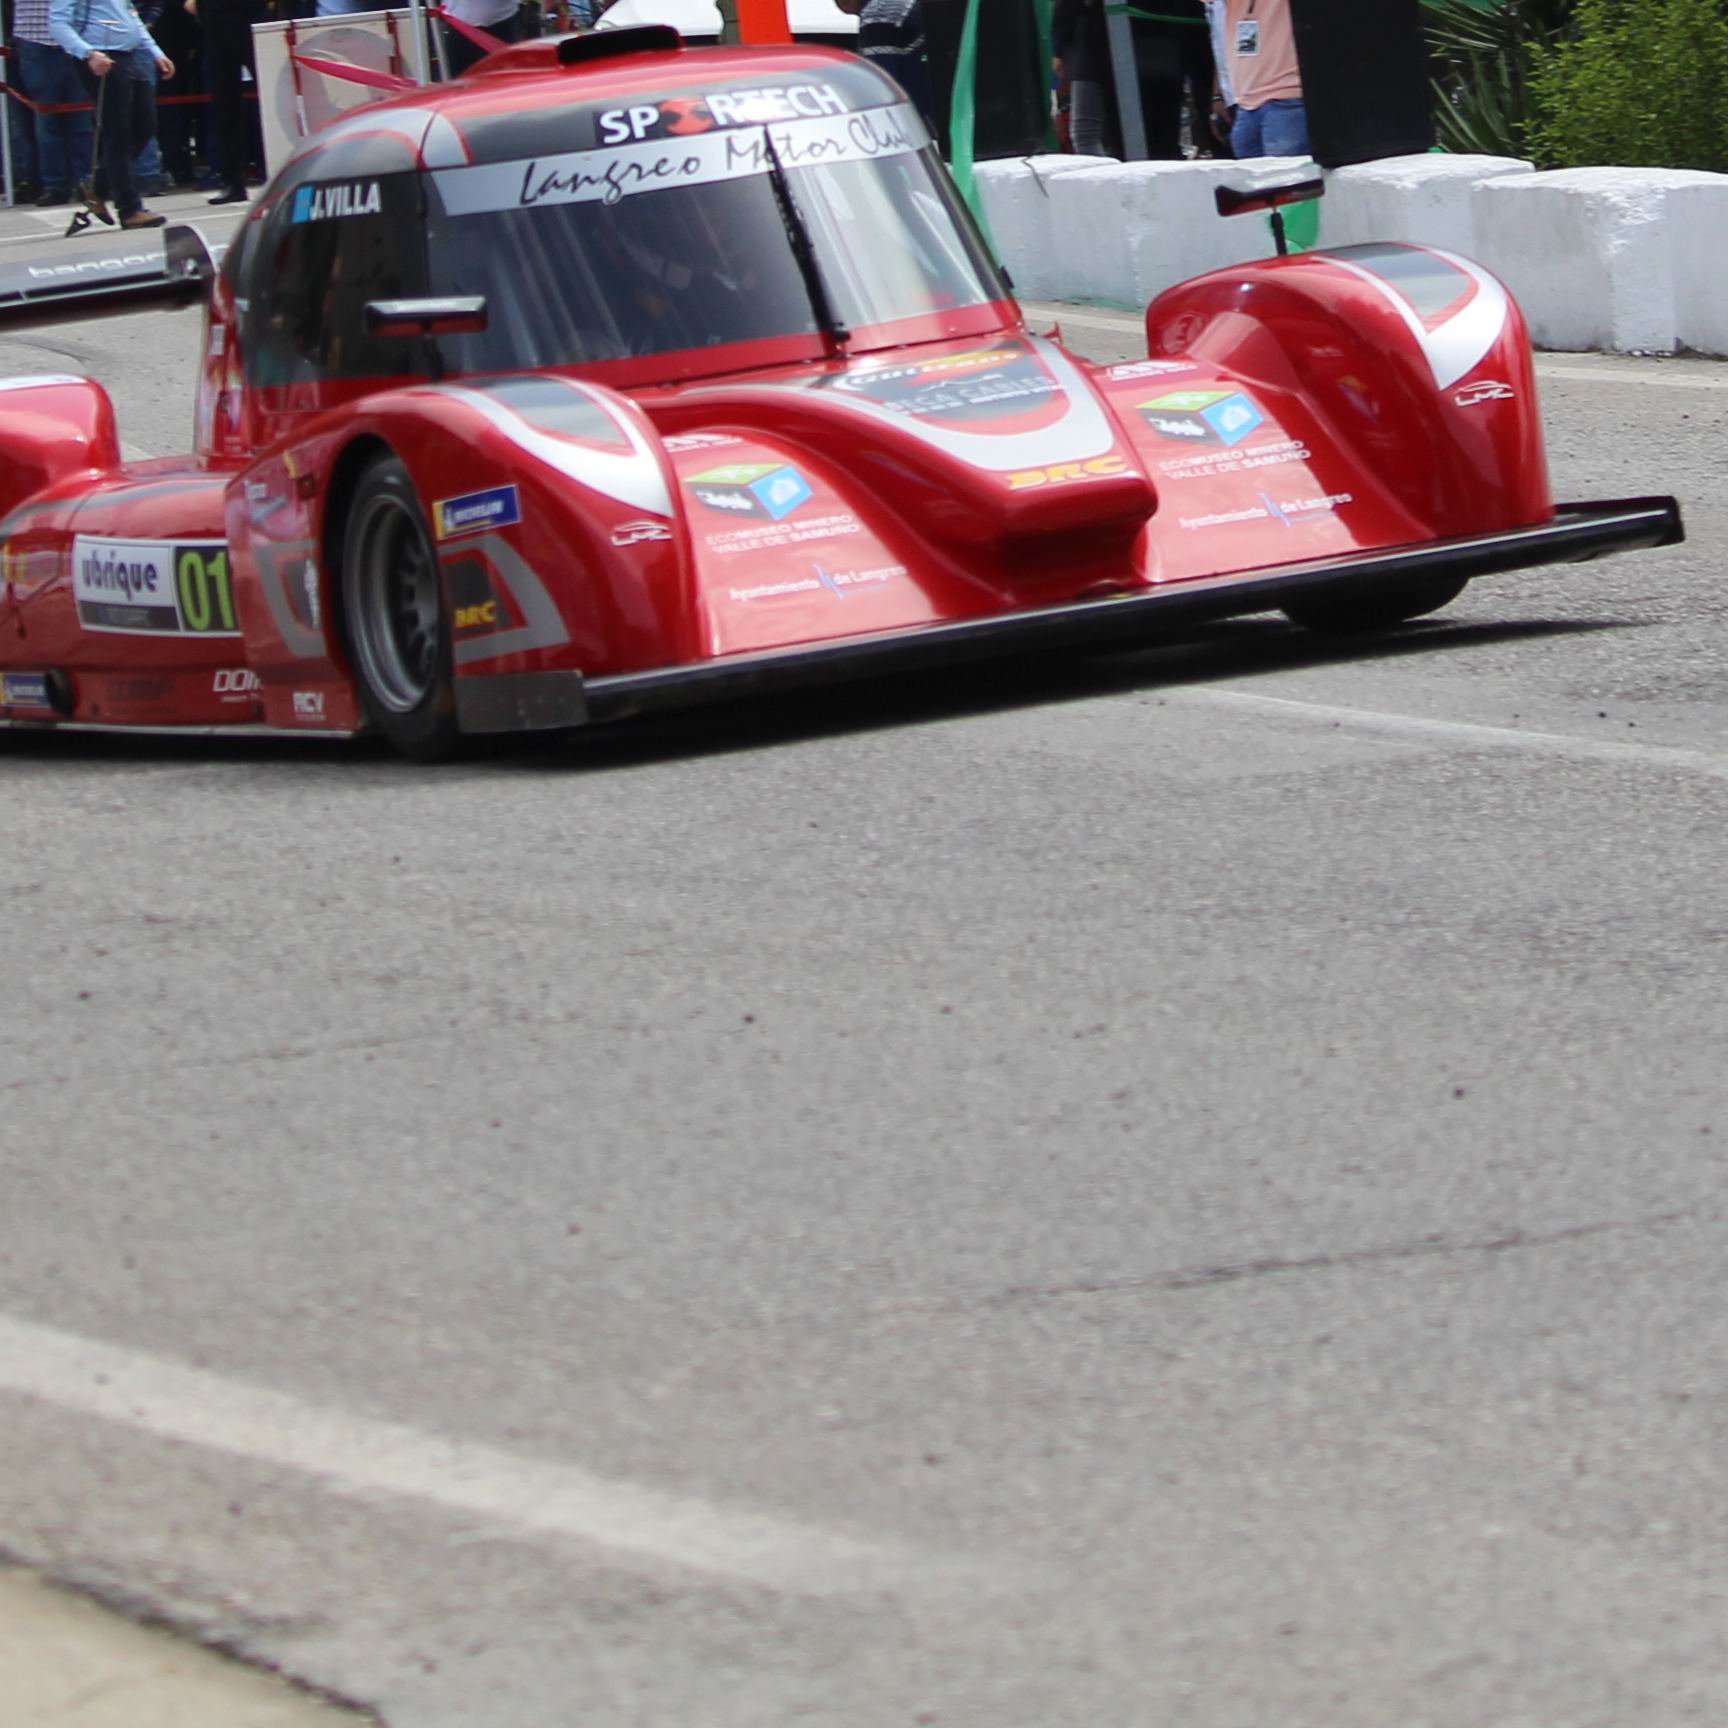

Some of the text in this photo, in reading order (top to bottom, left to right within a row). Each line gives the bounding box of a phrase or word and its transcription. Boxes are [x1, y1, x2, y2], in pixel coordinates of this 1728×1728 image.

[1004, 455, 1128, 490] BRC
[81, 549, 158, 601] ubrique
[178, 551, 236, 631] 01
[453, 600, 497, 629] BRC
